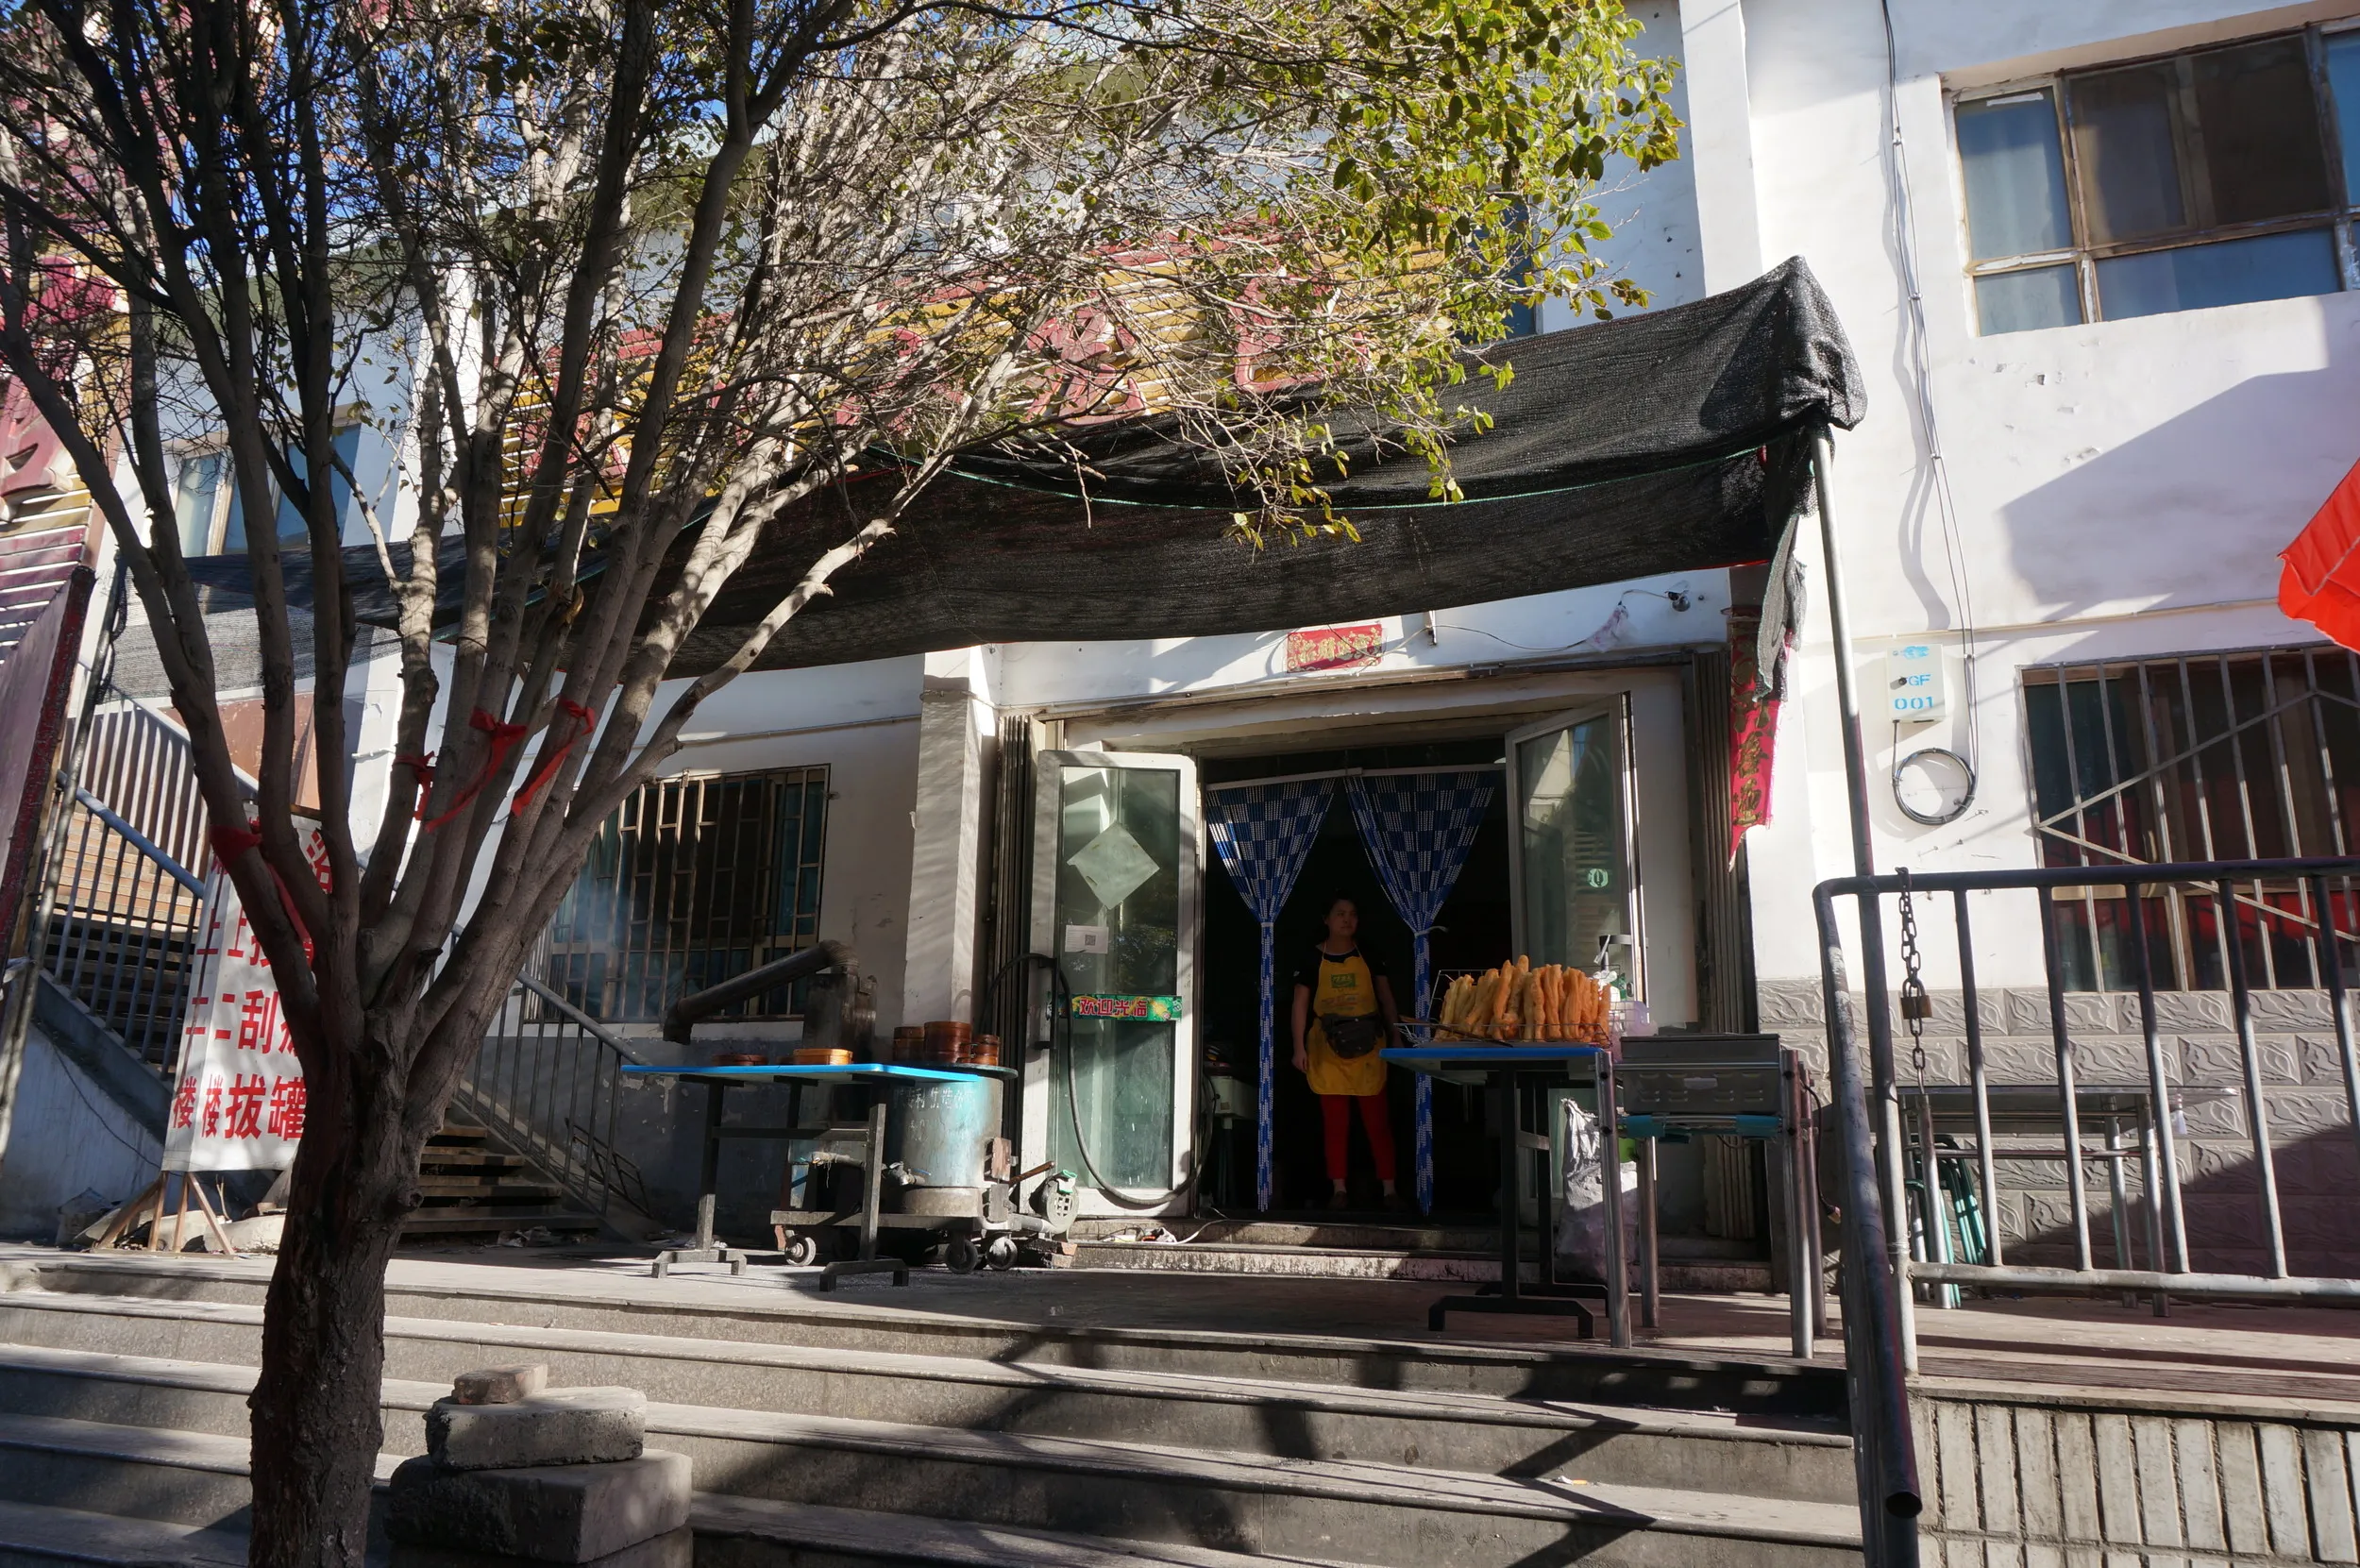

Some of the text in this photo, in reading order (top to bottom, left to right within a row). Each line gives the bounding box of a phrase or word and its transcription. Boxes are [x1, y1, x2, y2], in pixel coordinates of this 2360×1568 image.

[1894, 696, 1934, 710] 001
[1079, 998, 1148, 1017] 欢迎光临
[225, 1073, 308, 1141] 拔罐
